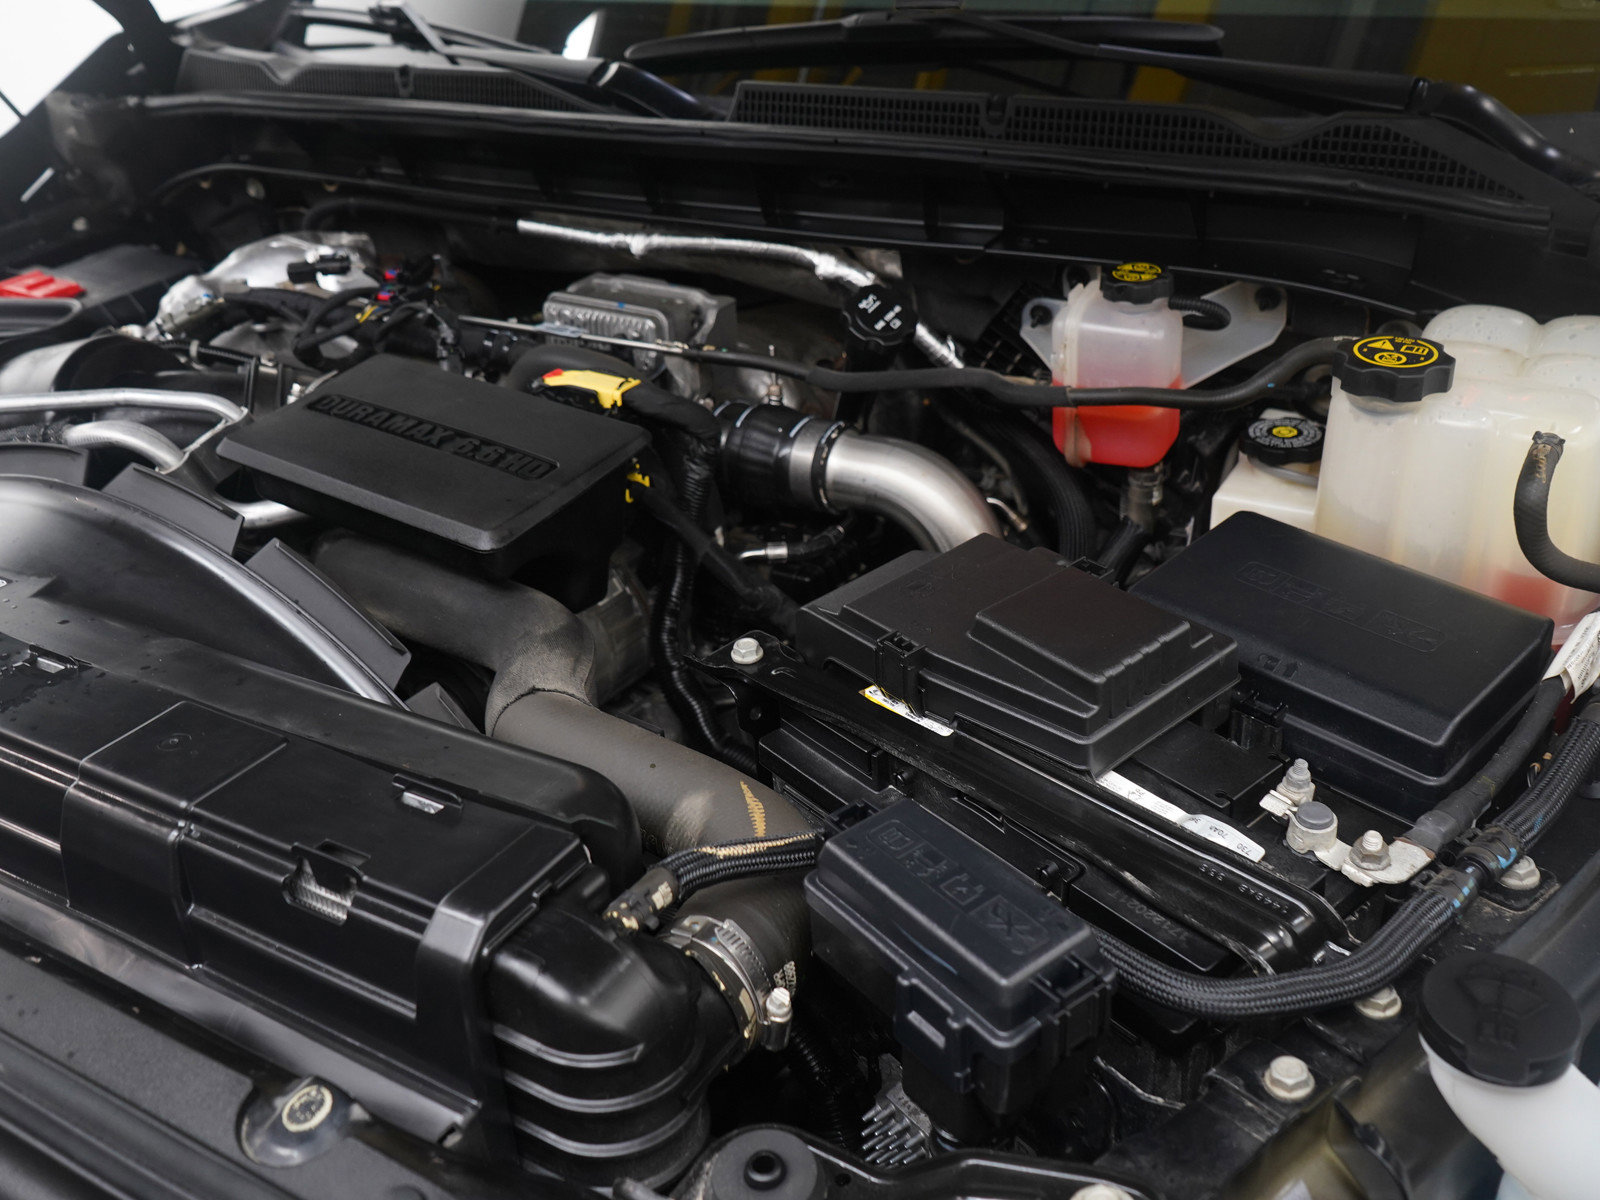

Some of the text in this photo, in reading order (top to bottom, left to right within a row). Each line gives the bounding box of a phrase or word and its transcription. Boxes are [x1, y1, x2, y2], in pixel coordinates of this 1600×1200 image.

[317, 396, 557, 480] DURAMAX 6.6 HD
[1236, 842, 1252, 857] 730
